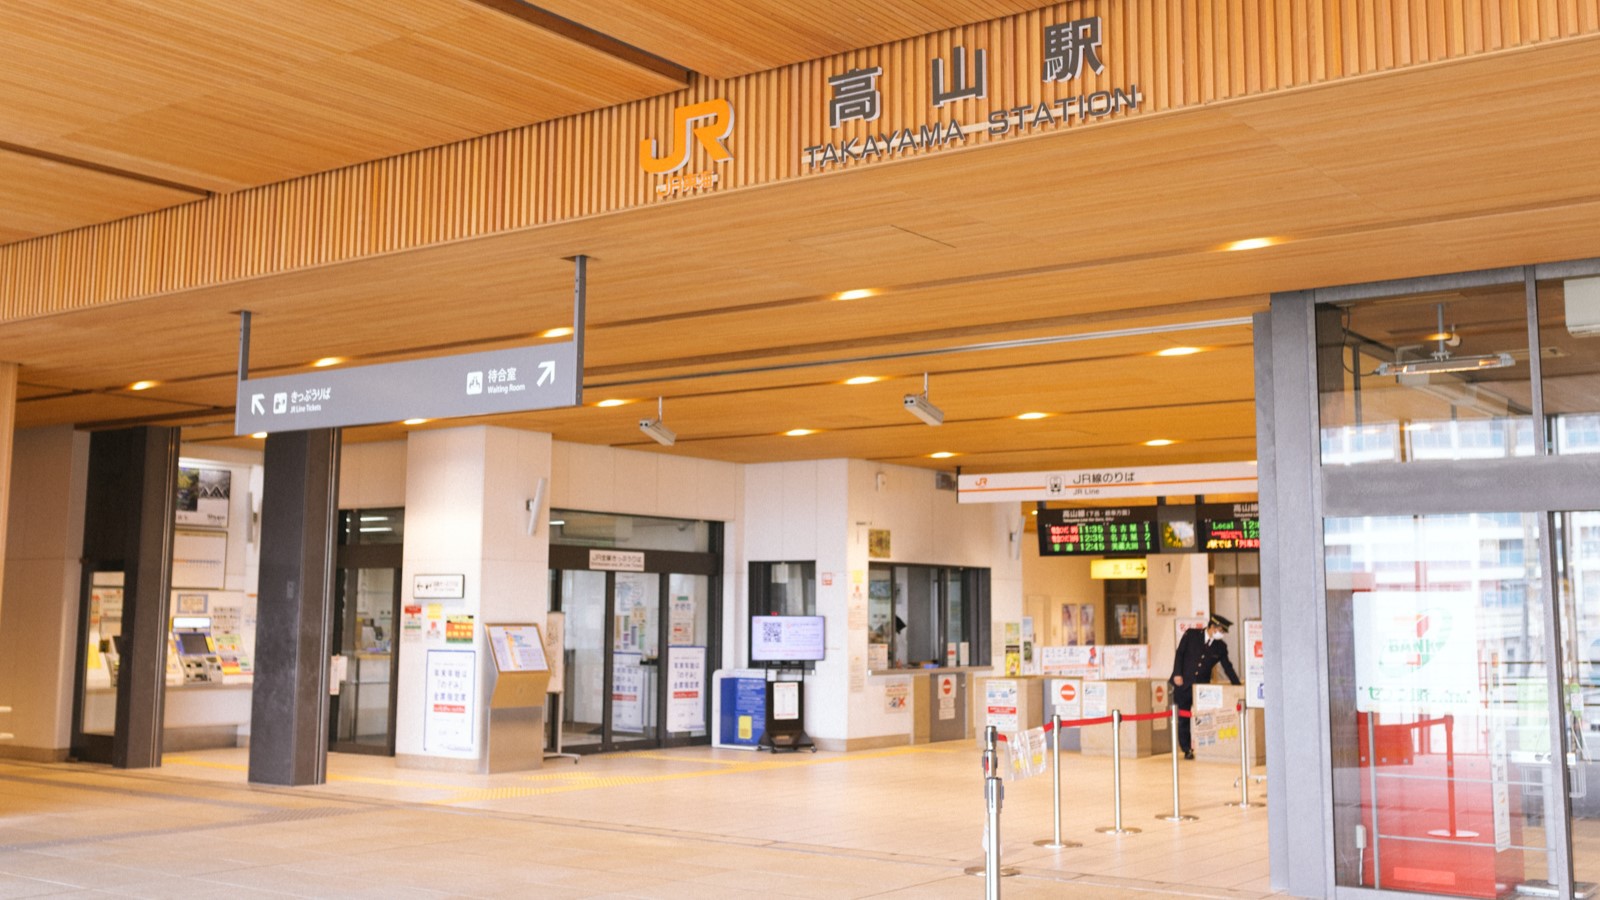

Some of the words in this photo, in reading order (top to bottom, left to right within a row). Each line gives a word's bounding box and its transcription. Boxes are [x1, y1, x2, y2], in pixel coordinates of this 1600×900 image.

[828, 16, 1104, 128] 高山駅
[804, 119, 966, 168] TAKAYAMA
[988, 84, 1137, 136] STATION
[640, 98, 734, 174] JR
[488, 368, 517, 383] 待合室
[488, 385, 509, 394] Waiting
[509, 384, 525, 392] Room
[291, 387, 331, 403] きっぷうりば
[975, 477, 987, 486] JR
[1073, 472, 1134, 484] JR線のりば
[1145, 523, 1149, 532] 1
[1212, 521, 1234, 530] Local
[1080, 533, 1104, 542] 12:35
[1145, 533, 1150, 541] 2
[1080, 541, 1105, 551] 12:45
[1146, 541, 1150, 550] 1
